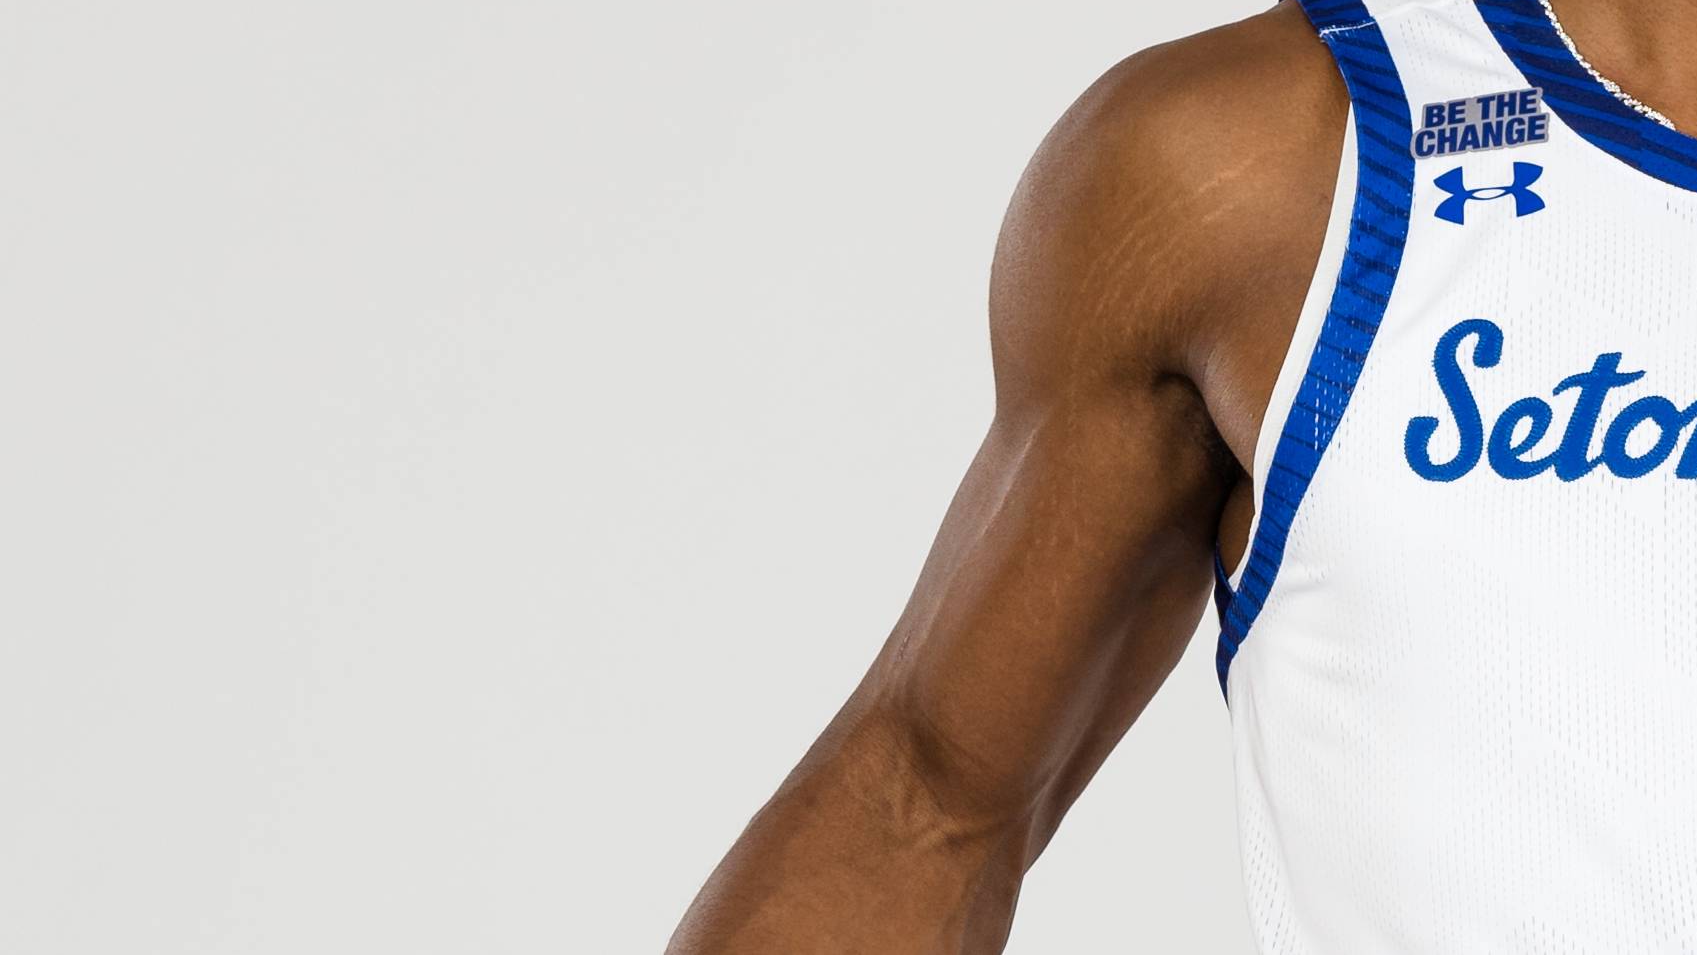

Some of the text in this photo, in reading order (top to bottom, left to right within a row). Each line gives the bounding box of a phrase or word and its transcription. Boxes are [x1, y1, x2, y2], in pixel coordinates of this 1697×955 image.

[1425, 89, 1538, 128] BE THE
[1415, 115, 1546, 157] CHANGE
